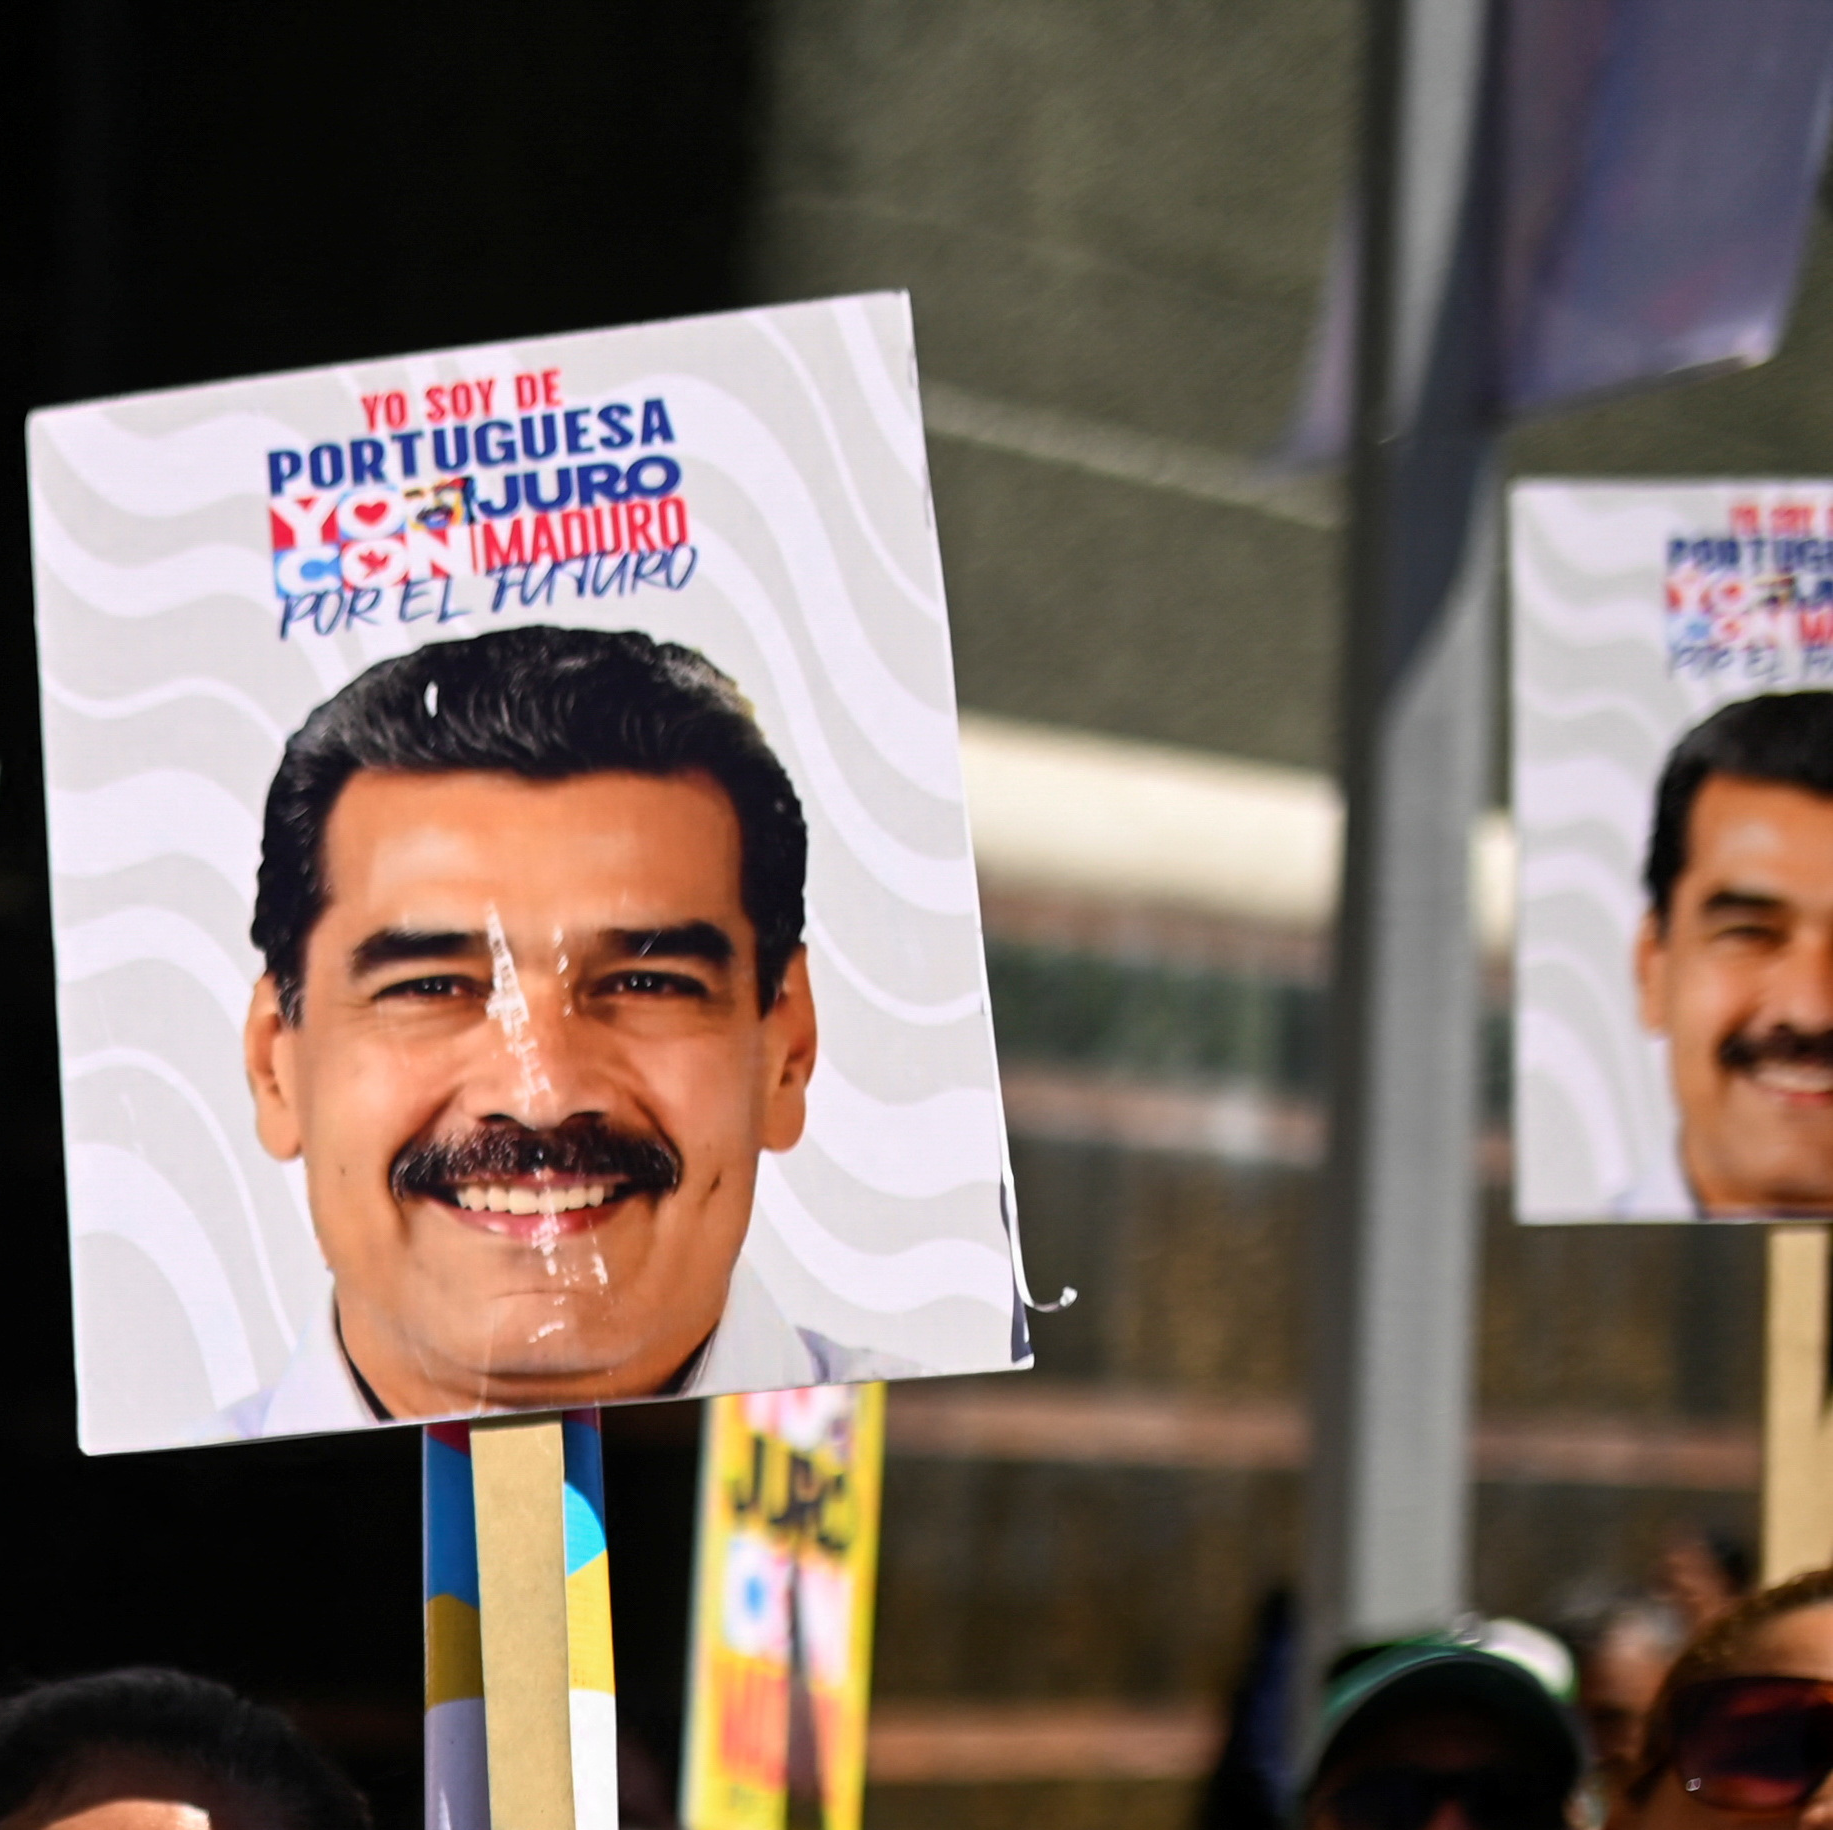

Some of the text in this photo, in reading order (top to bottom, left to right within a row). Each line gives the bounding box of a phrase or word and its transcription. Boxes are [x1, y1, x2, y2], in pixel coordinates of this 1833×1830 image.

[267, 397, 675, 496] PORTUGUESA
[361, 367, 562, 433] YO SOY DE
[270, 455, 682, 550] YO JURO
[274, 494, 691, 599] CON MADURO
[280, 542, 698, 641] POR EL FUTURO
